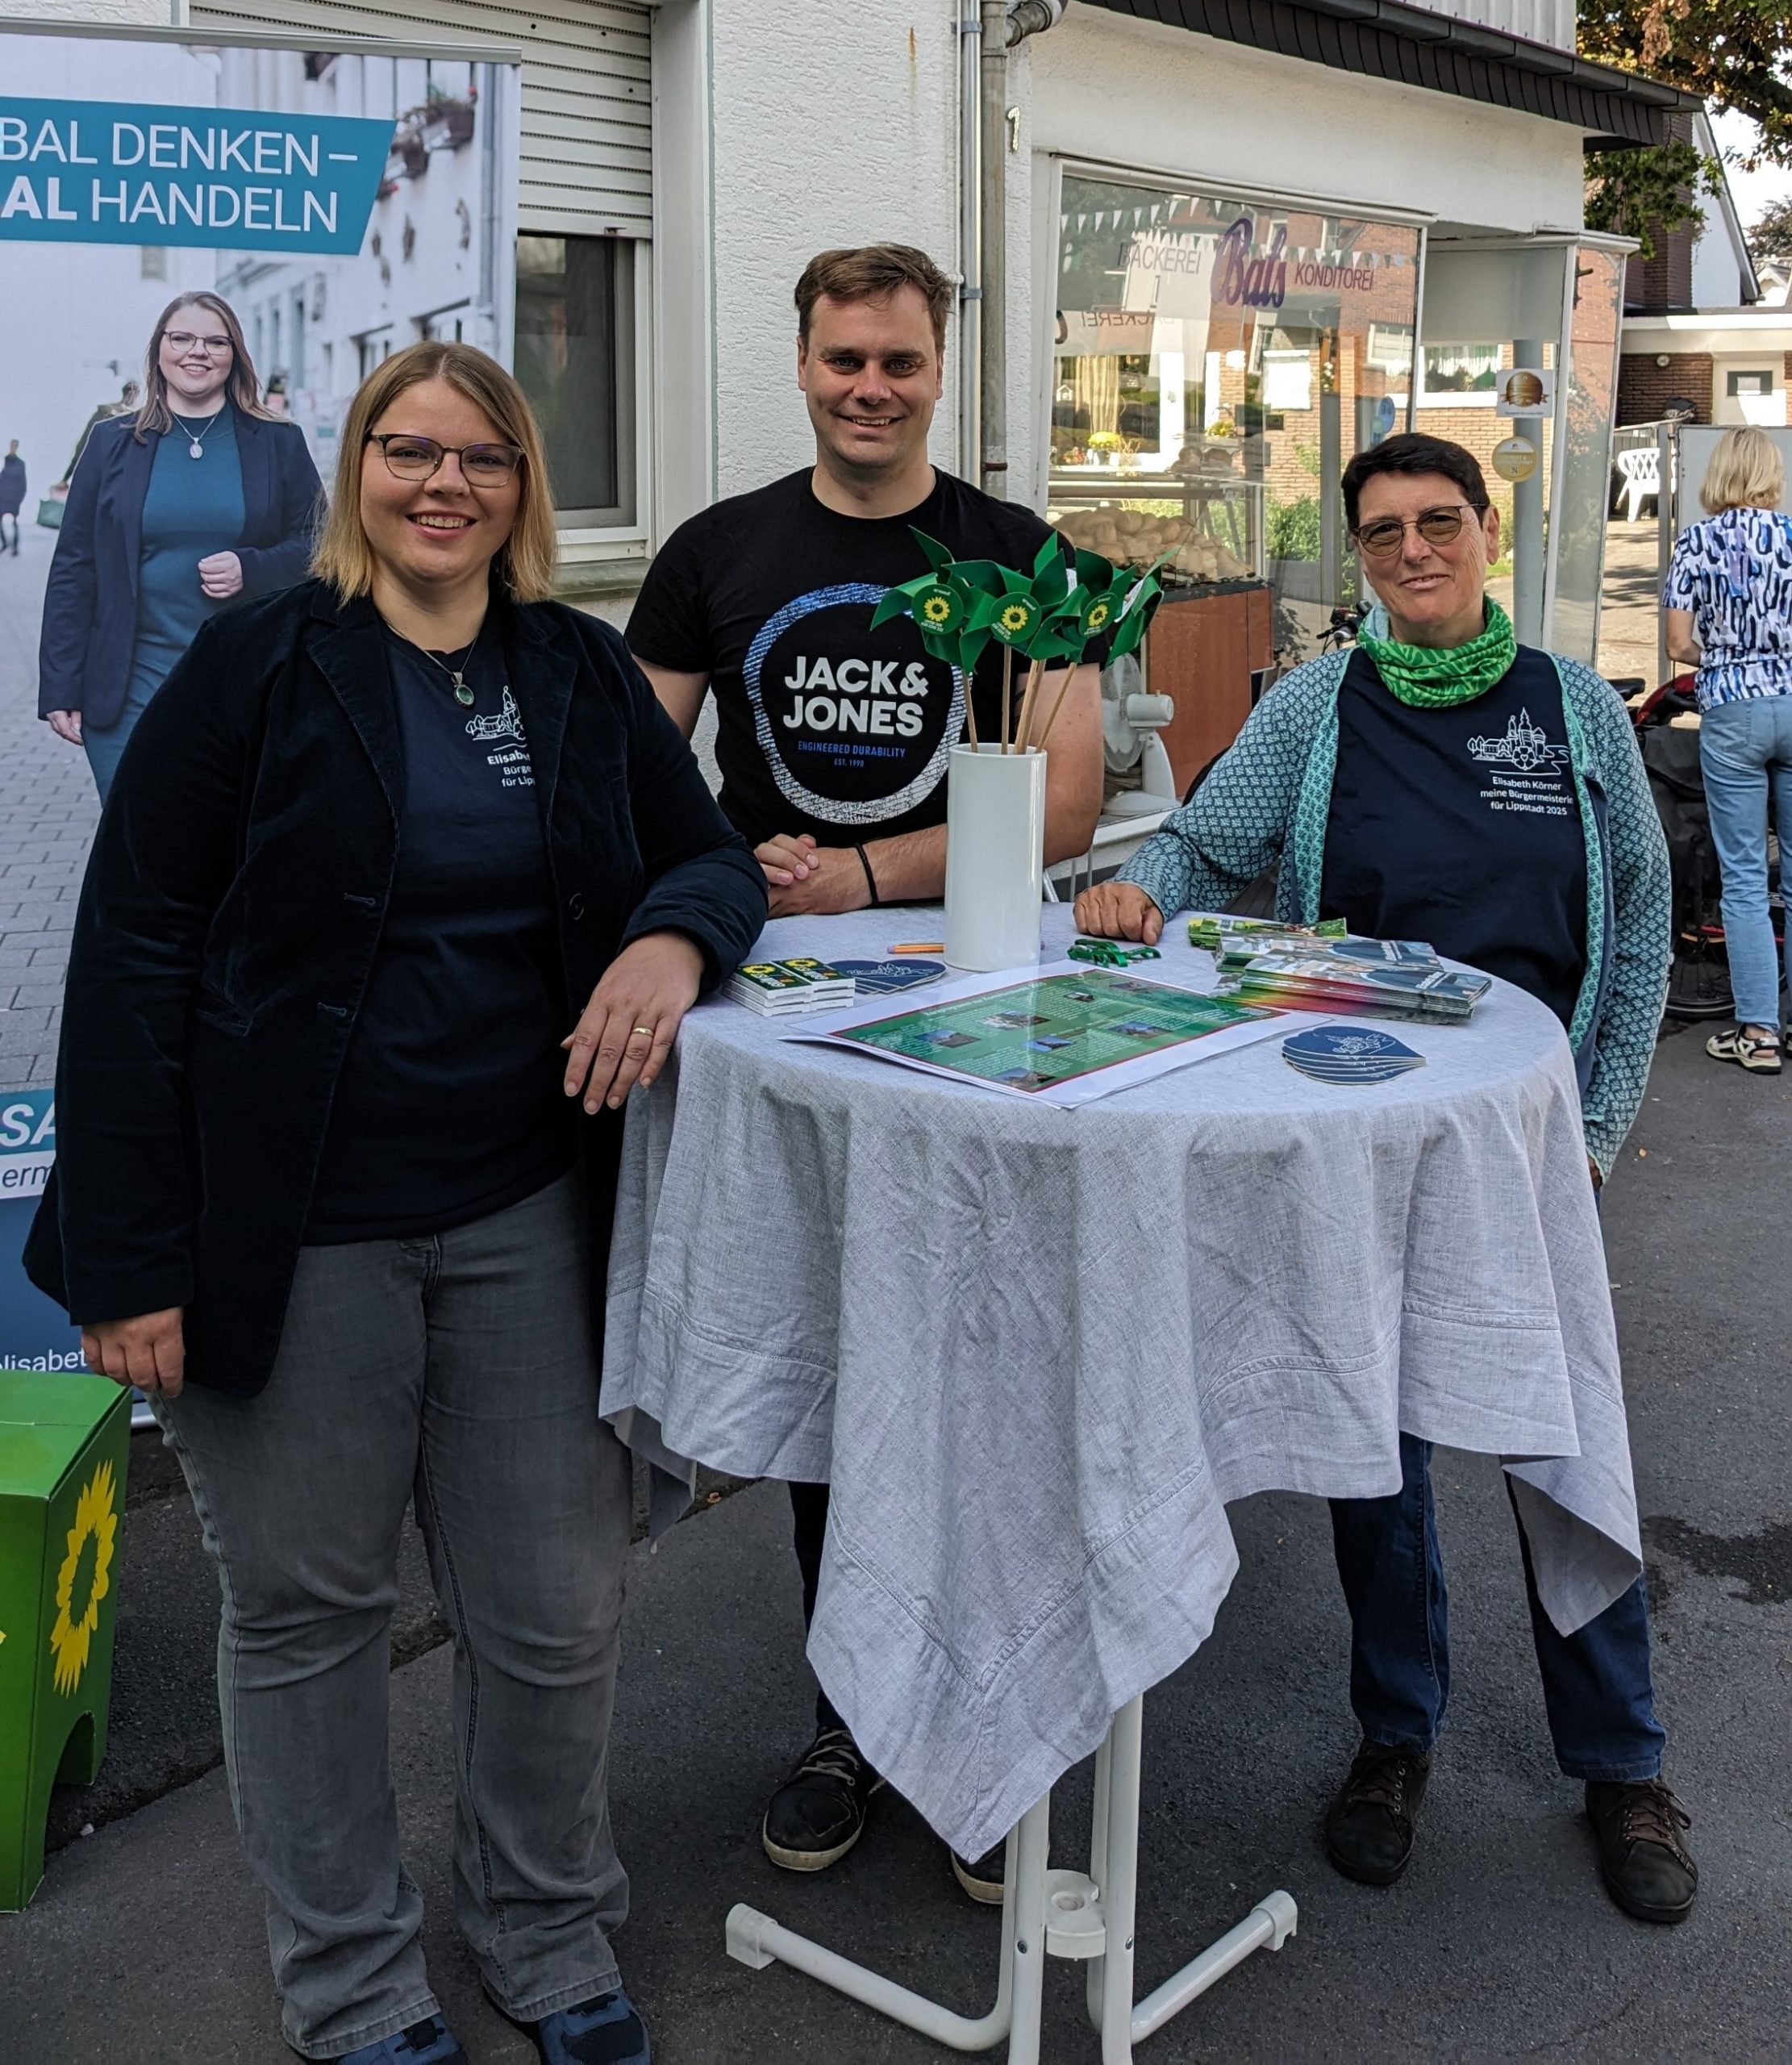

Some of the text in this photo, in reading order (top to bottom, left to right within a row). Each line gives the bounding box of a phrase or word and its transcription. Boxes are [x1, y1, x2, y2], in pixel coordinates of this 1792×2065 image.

[0, 116, 98, 165] BAL
[112, 122, 319, 177] DENKEN
[0, 175, 337, 233] AL HANDELN
[1294, 262, 1374, 291] KONDITOREI
[784, 656, 929, 697] JACK&
[782, 695, 924, 737] JONES
[798, 740, 906, 757] ENGINEERED DURABILITY
[834, 758, 865, 767] EST. 1990
[502, 778, 517, 787] für
[1492, 776, 1562, 791] Elisabeth Körner
[1480, 788, 1507, 798] meine
[1490, 800, 1568, 816] für Lippstadt 2025
[0, 1348, 88, 1371] lisabet
